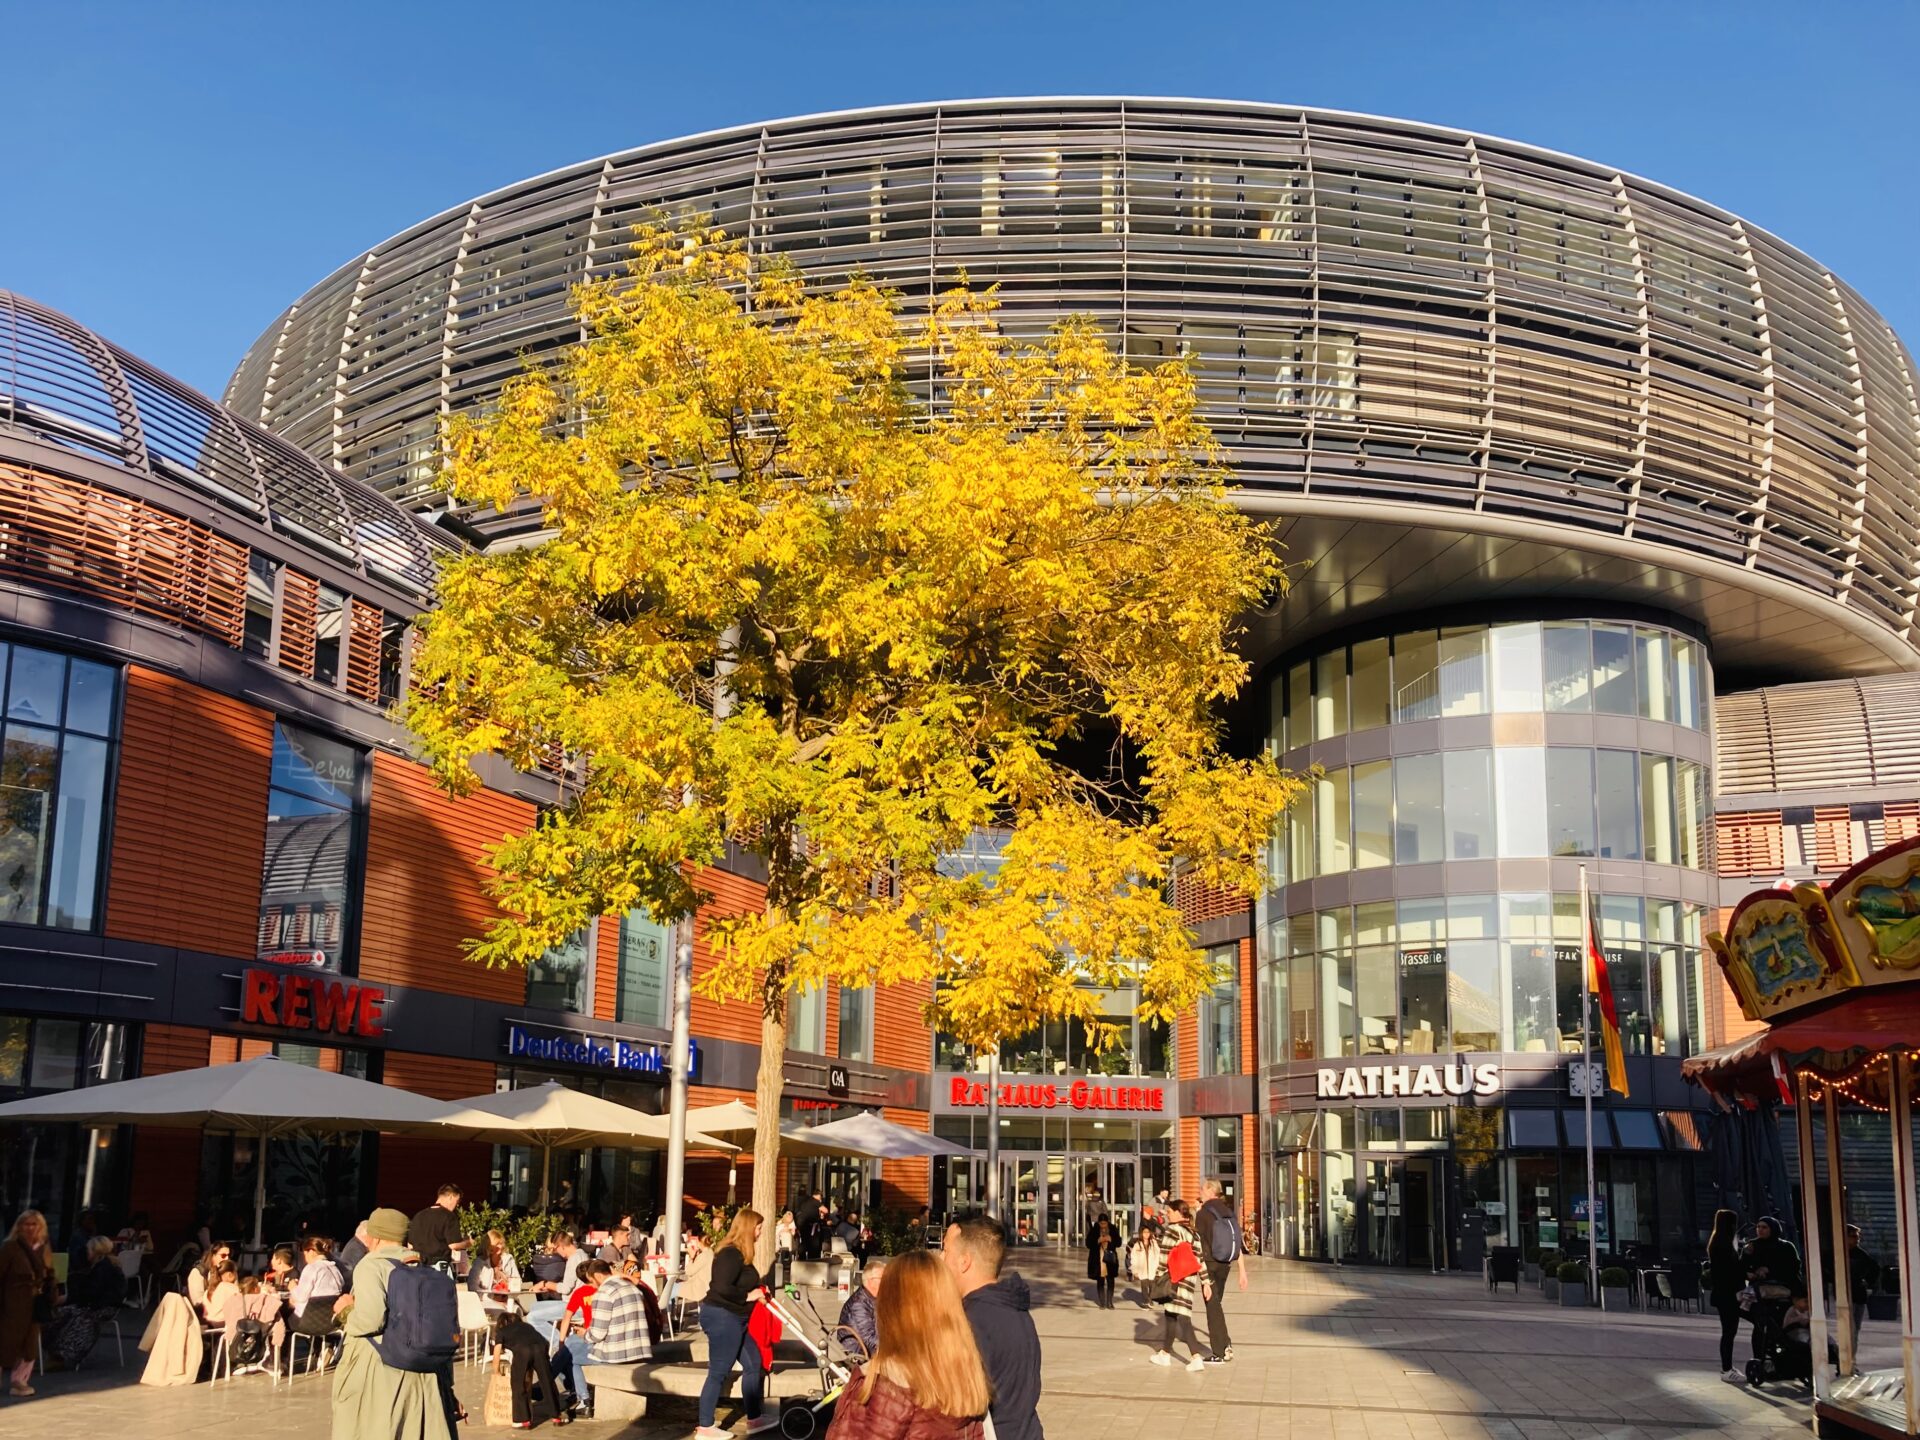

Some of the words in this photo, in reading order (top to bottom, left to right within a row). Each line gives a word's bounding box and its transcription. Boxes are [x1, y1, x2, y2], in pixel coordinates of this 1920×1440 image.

[1549, 950, 1577, 961] TEAK
[242, 968, 385, 1038] REWE
[509, 1026, 611, 1067] Deutsche
[614, 1041, 663, 1075] Bank
[950, 1076, 1164, 1110] RAHAUS-GALERIE
[1317, 1063, 1501, 1098] RATHAUS
